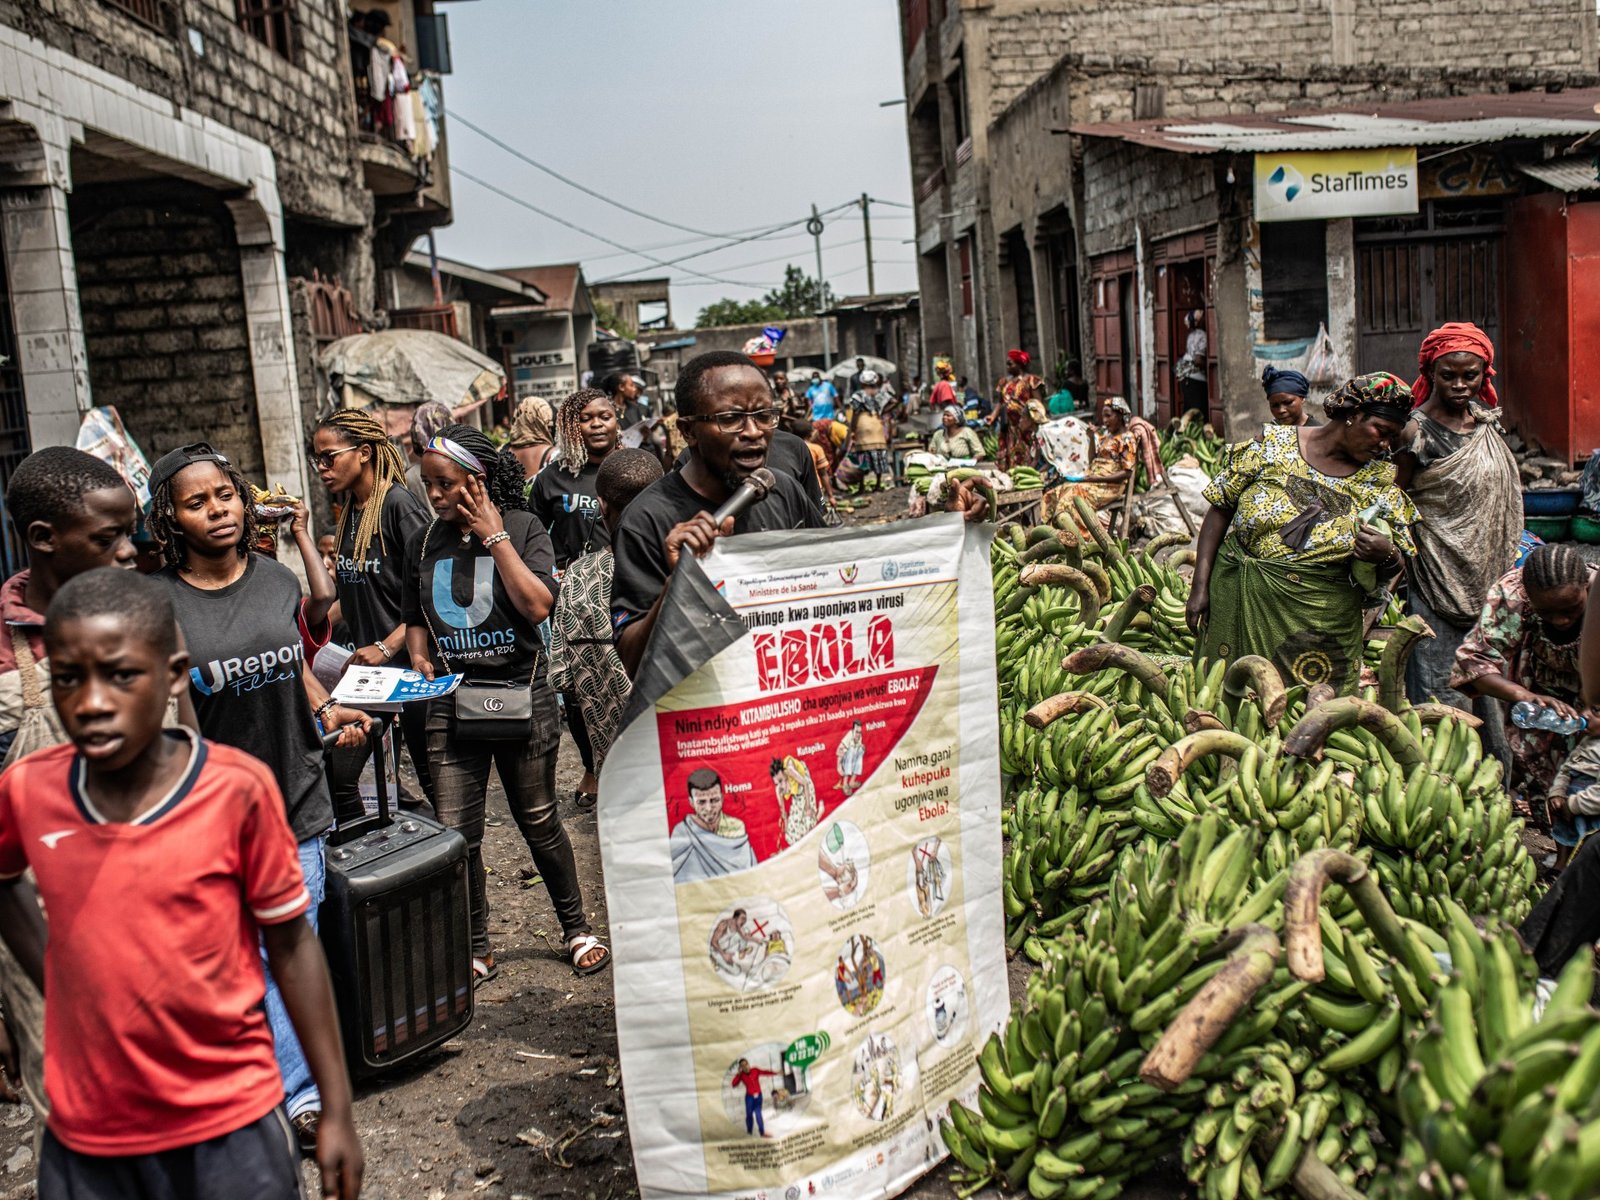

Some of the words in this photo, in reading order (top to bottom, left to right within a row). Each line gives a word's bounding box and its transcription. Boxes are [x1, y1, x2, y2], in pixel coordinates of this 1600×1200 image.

[1311, 171, 1408, 194] StarTimes
[432, 556, 495, 629] U
[749, 586, 779, 598] Ministère
[781, 585, 789, 593] de
[790, 584, 797, 592] la
[798, 582, 818, 592] Santé
[788, 607, 809, 623] kwa
[813, 600, 856, 620] ugonjwa
[858, 599, 872, 612] wa
[876, 593, 904, 610] virusi
[437, 628, 515, 650] millions
[495, 645, 516, 655] RDC
[753, 614, 895, 692] EBOLA
[675, 718, 702, 734] Nini
[704, 714, 739, 732] ndiyo
[740, 698, 801, 727] KITAMBULISHO
[802, 695, 816, 711] cha
[818, 690, 852, 710] ugonjwa
[853, 689, 865, 700] wa
[866, 683, 887, 698] virusi
[888, 676, 920, 694] EBOLA?
[677, 732, 749, 750] Inatambulishwa
[781, 723, 786, 732] 2
[818, 714, 826, 723] 21
[893, 698, 907, 707] kwa
[678, 743, 740, 758] vitambulisho
[797, 742, 826, 757] Kutapika
[894, 754, 929, 772] Namna
[930, 746, 952, 767] gani
[724, 782, 752, 794] Homa
[901, 765, 951, 789] kuhepuka
[894, 790, 934, 813] ugonjwa
[935, 786, 949, 798] wa
[918, 800, 950, 822] Ebola?
